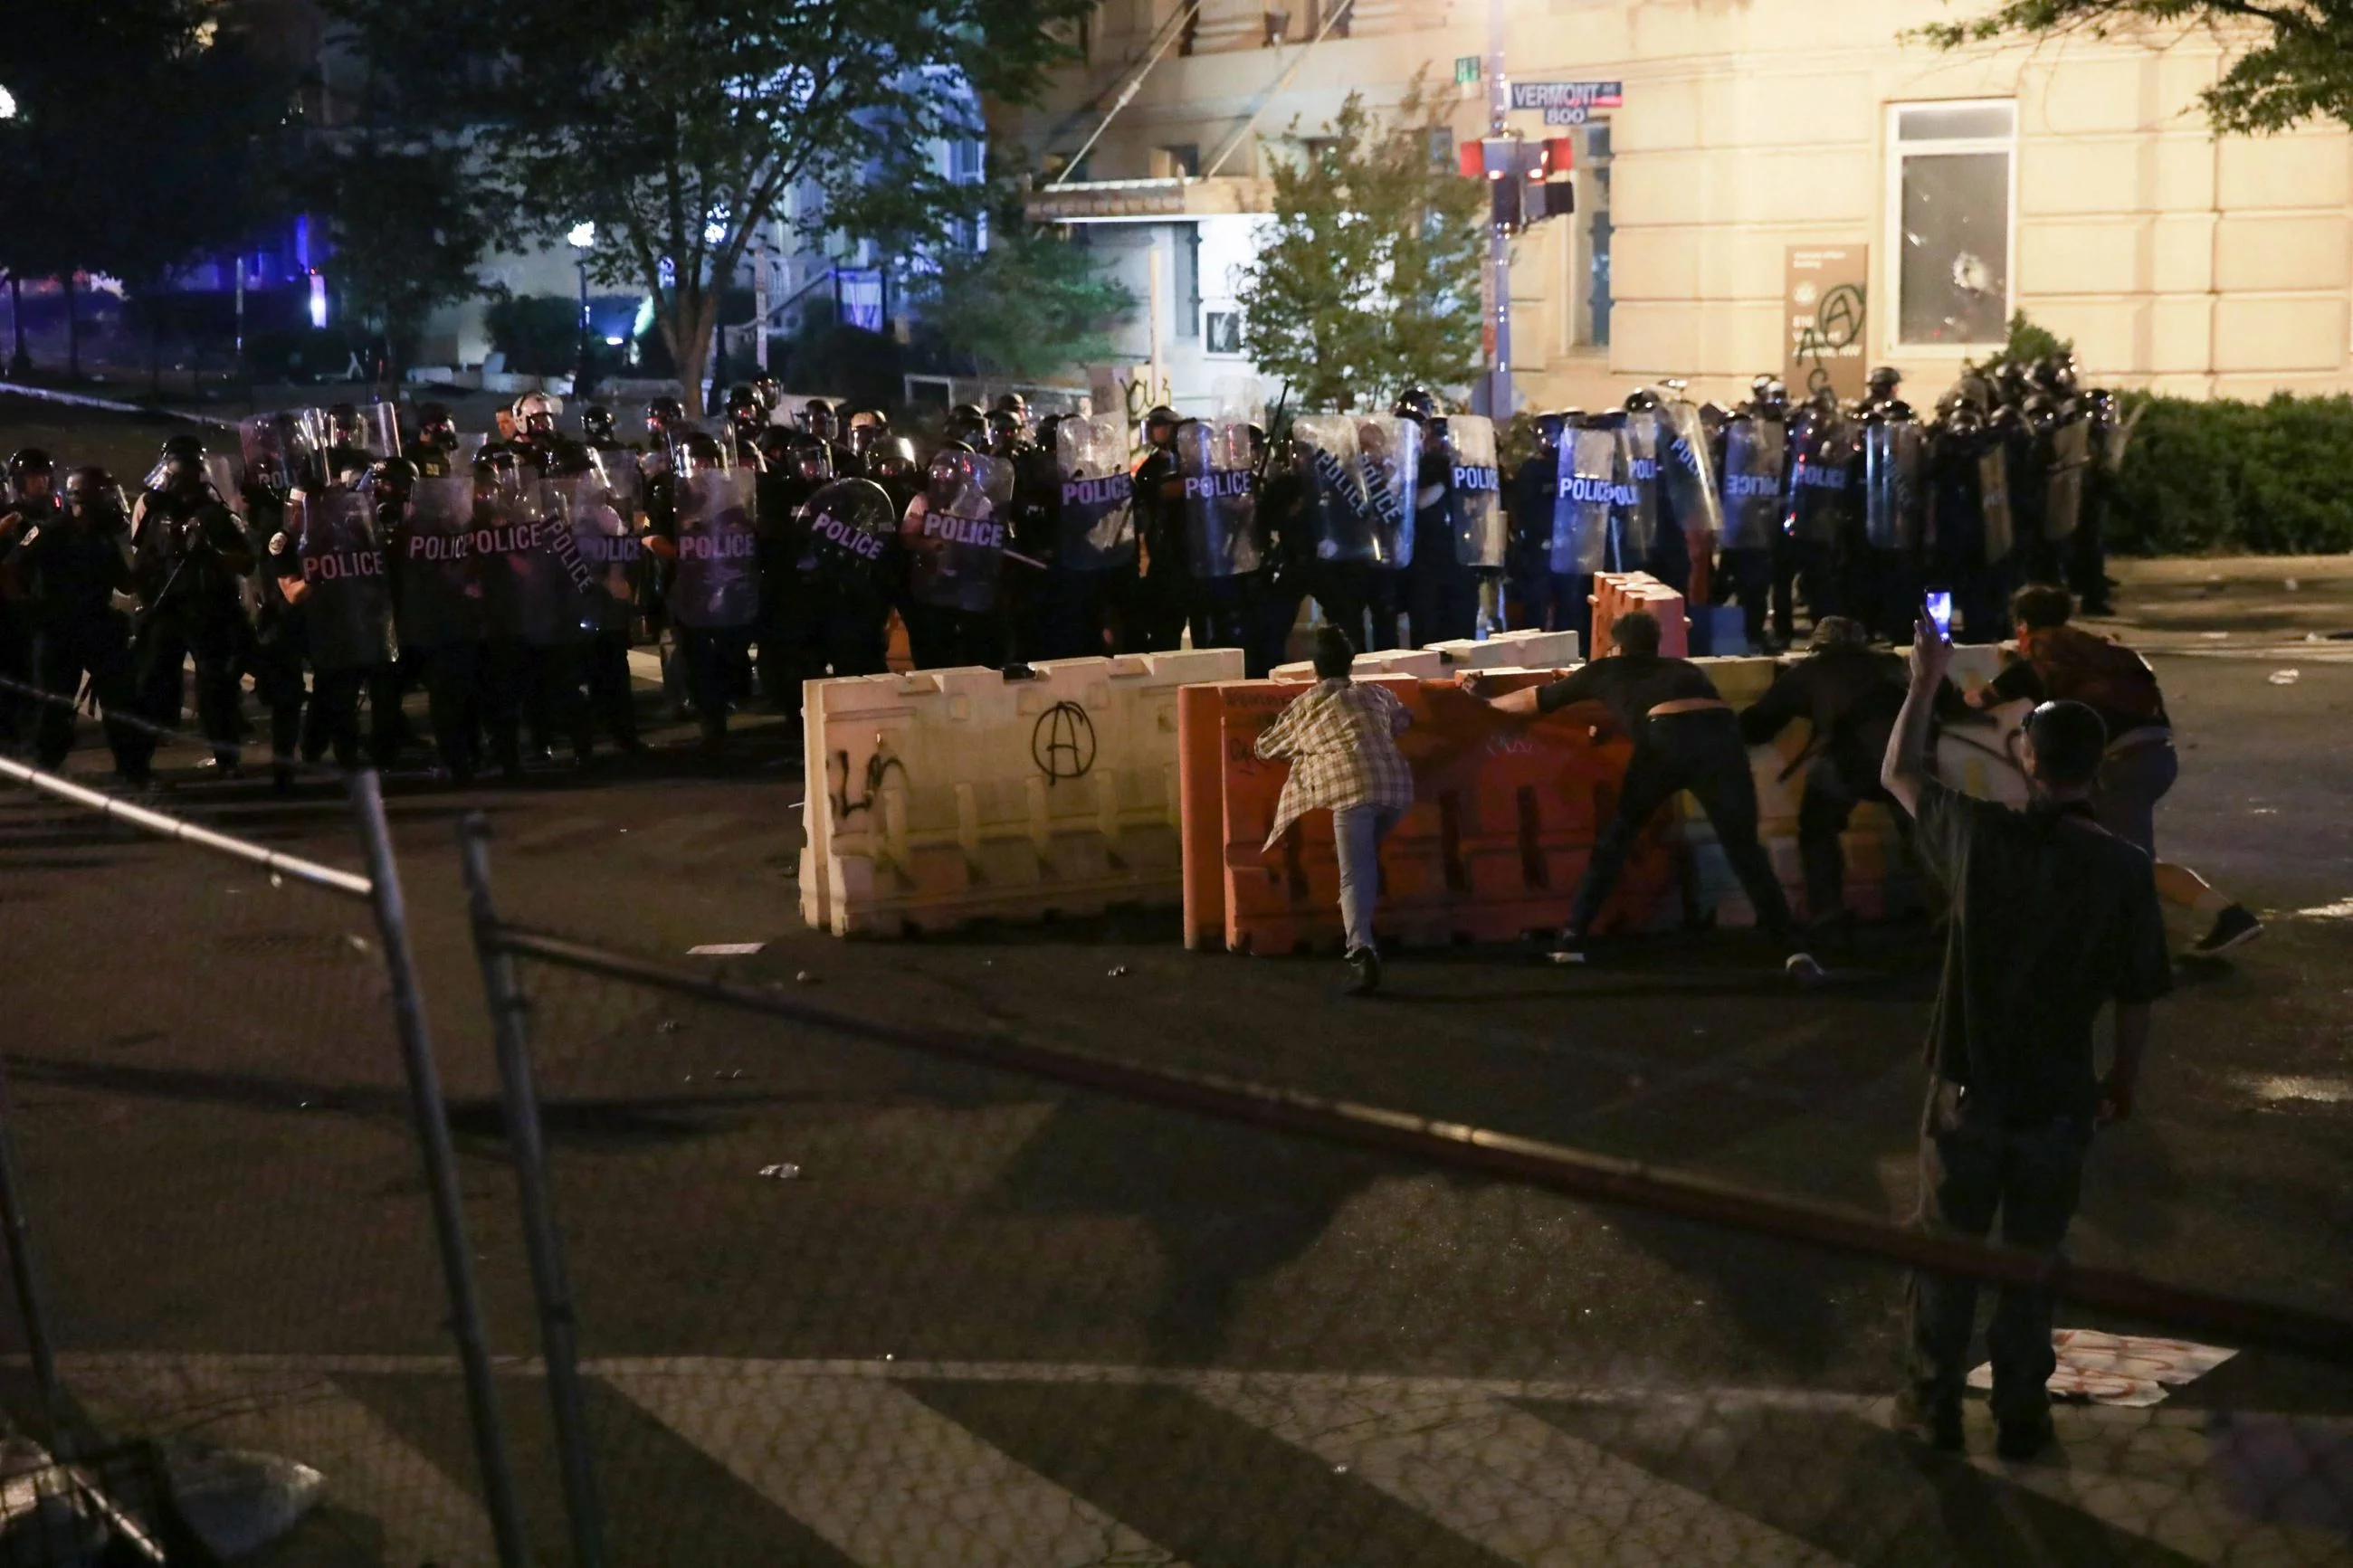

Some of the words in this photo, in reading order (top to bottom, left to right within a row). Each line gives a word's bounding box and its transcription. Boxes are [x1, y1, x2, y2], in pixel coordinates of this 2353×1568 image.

[1513, 84, 1599, 107] VERMONT
[1546, 109, 1585, 125] 800
[1062, 473, 1132, 506] POLICE
[1185, 470, 1253, 500] POLICE
[812, 512, 884, 560] POLICE
[923, 512, 1005, 547] POLICE
[544, 519, 594, 594] POLICE
[679, 532, 755, 561] POLICE
[303, 550, 384, 582] POLICE
